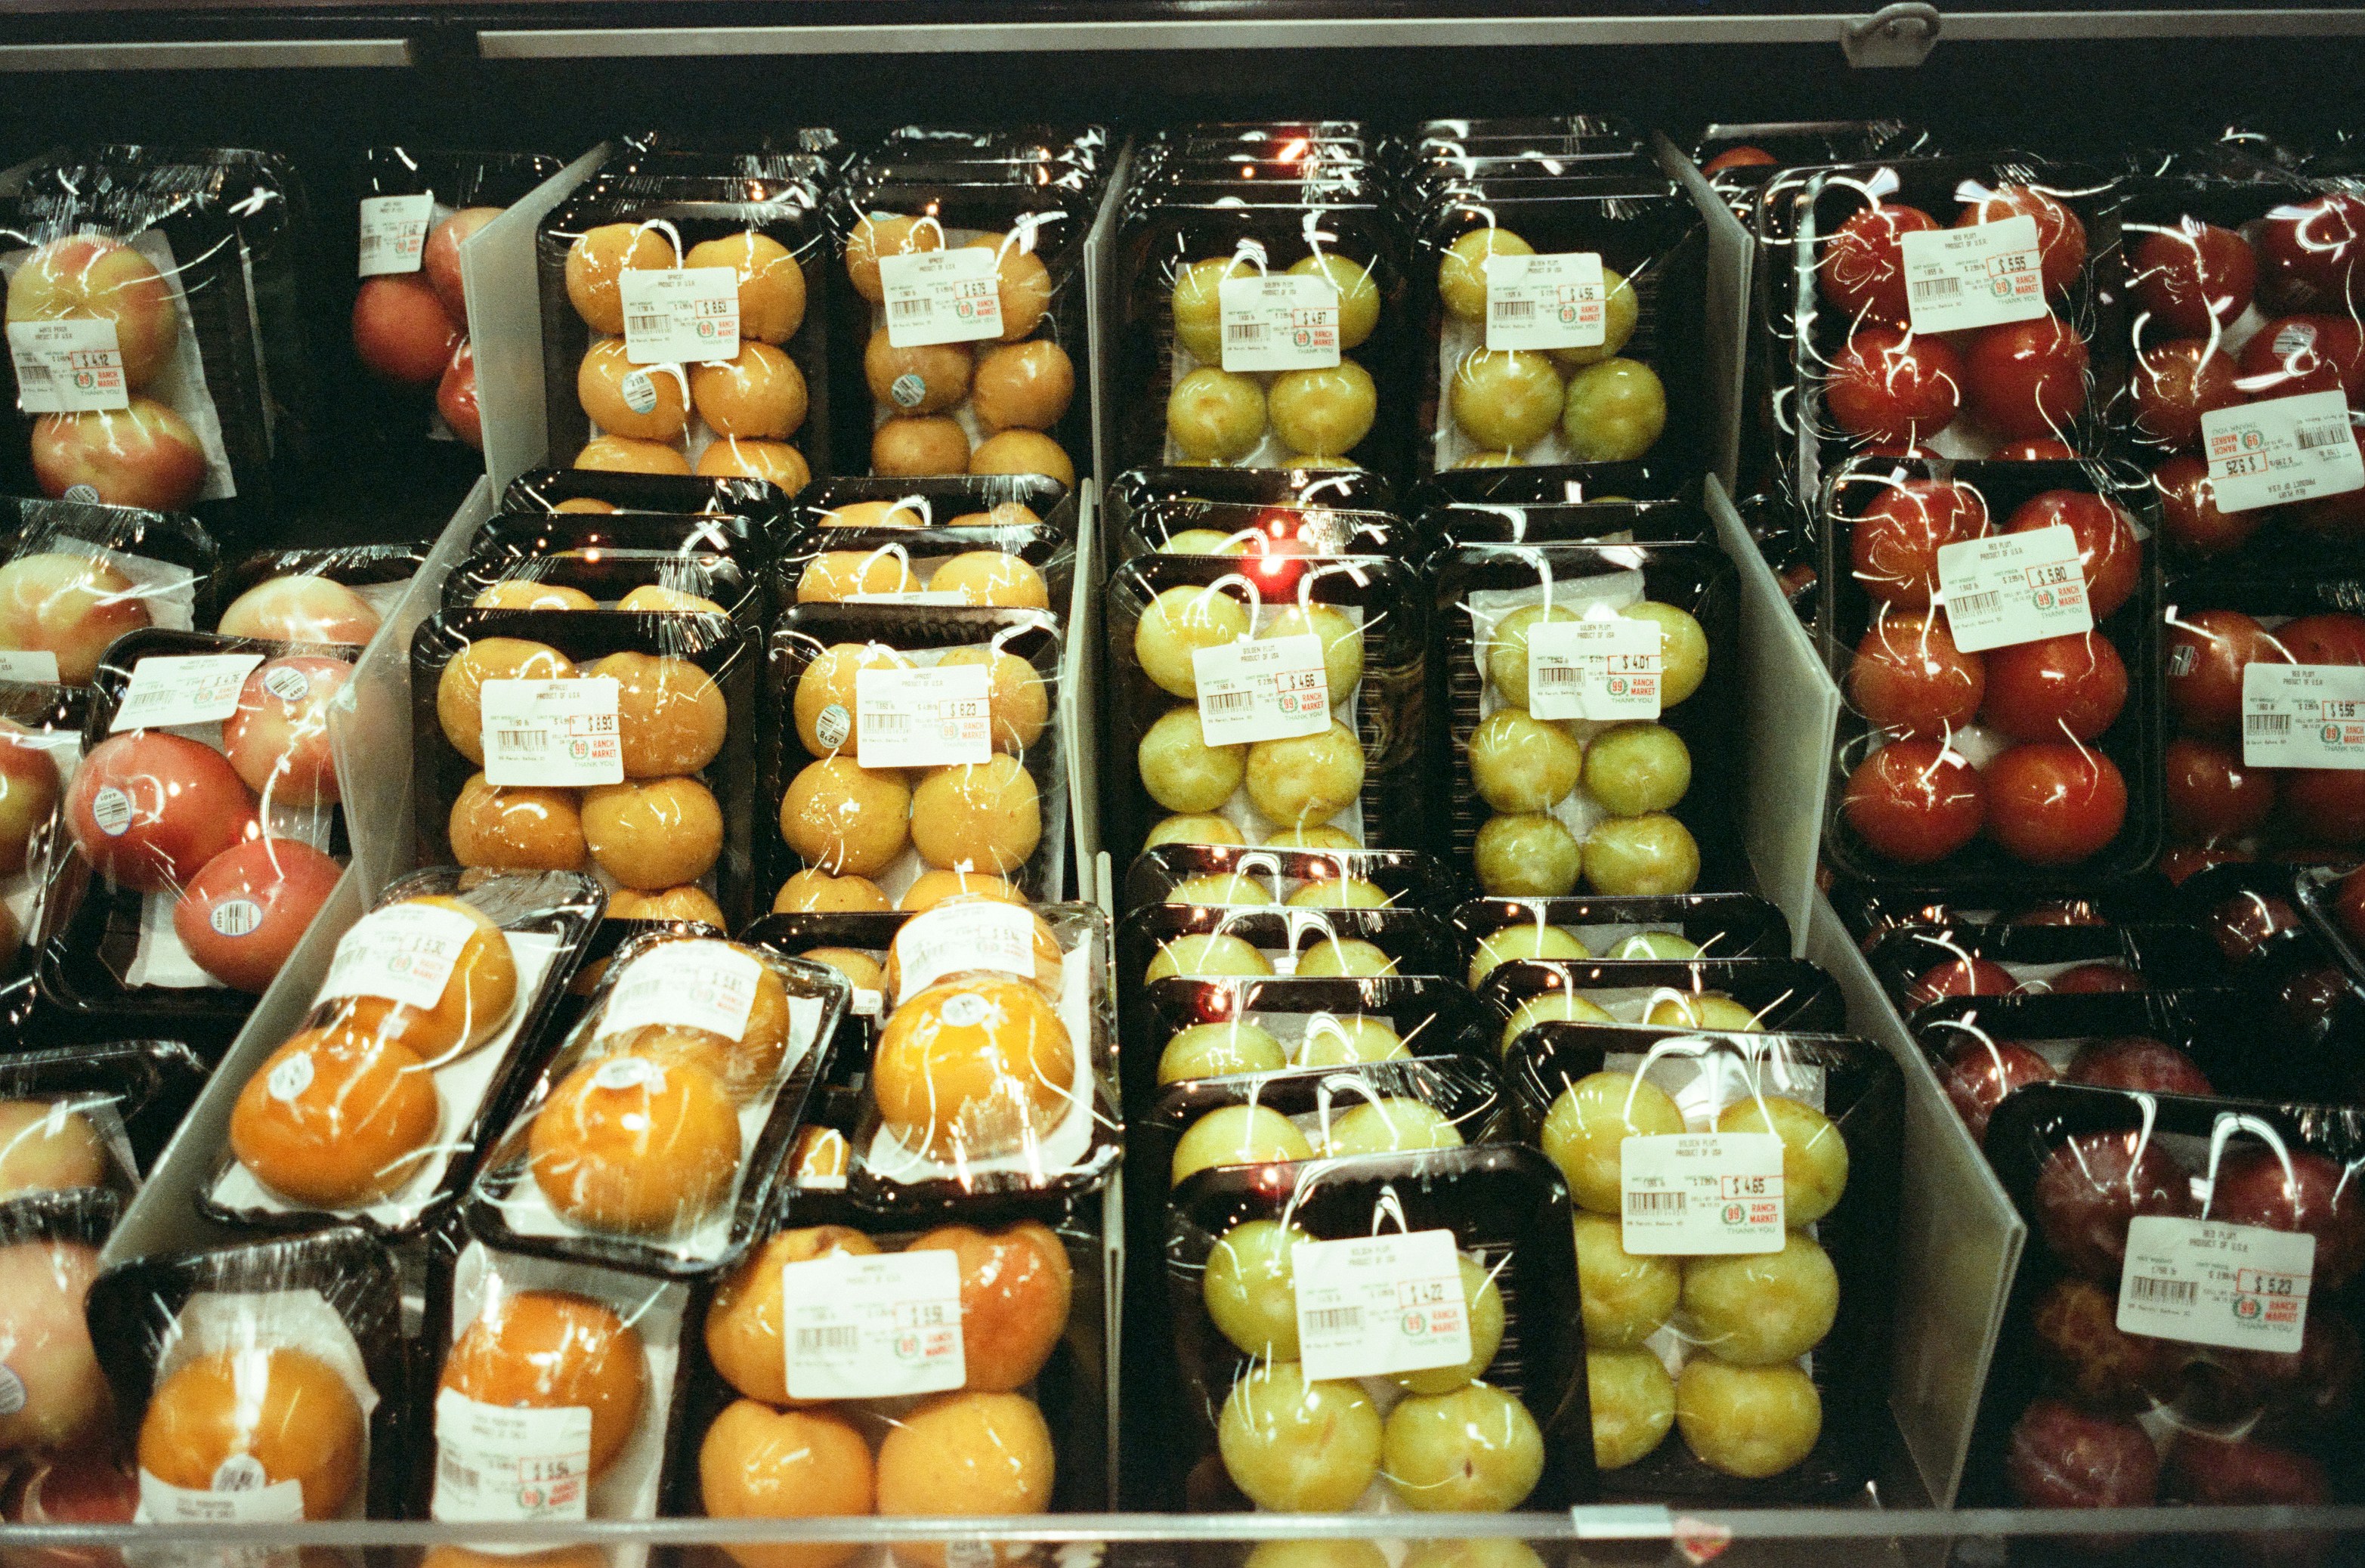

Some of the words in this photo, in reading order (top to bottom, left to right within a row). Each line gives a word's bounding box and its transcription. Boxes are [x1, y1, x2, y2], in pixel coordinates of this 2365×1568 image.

[1998, 258, 2005, 274] $
[2008, 255, 2026, 272] 5.55
[2014, 275, 2036, 284] RANCH
[2014, 284, 2039, 295] MARKET
[1998, 296, 2021, 305] THANK
[1579, 314, 1600, 322] MARKET
[82, 354, 88, 367] $
[2231, 422, 2258, 431] THANK
[2211, 435, 2237, 447] MARKET
[2214, 444, 2237, 455] RANCH
[2226, 458, 2246, 475] 5.25
[2249, 456, 2256, 472] $
[1980, 552, 2000, 561] PRODUCT
[2037, 570, 2045, 585] $
[2047, 566, 2067, 583] 5.80
[2057, 585, 2079, 596] RANCH
[2057, 595, 2082, 606] MARKET
[2041, 611, 2067, 619] THANK
[2069, 606, 2082, 614] YOU
[1241, 654, 1260, 663] PRODUCT
[1623, 654, 1628, 670] $
[1633, 654, 1649, 670] 4.01
[1290, 675, 1296, 689] $
[1300, 674, 1315, 688] 4.66
[289, 685, 305, 698] 4401
[1302, 692, 1322, 701] RANCH
[951, 703, 956, 717] $
[960, 703, 976, 716] 8.23
[1301, 700, 1324, 711] MARKET
[2330, 702, 2336, 718] $
[2338, 702, 2355, 717] 5.56
[588, 715, 594, 732] $
[597, 715, 614, 731] 8.93
[962, 731, 986, 739] MARKET
[2345, 725, 2364, 734] RANCH
[820, 730, 839, 745] 4218
[594, 739, 615, 748] RANCH
[592, 749, 617, 759] MARKET
[101, 792, 118, 802] 4401
[1733, 1177, 1739, 1195] $
[1751, 1204, 1776, 1213] RANCH
[1749, 1214, 1777, 1224] MARKET
